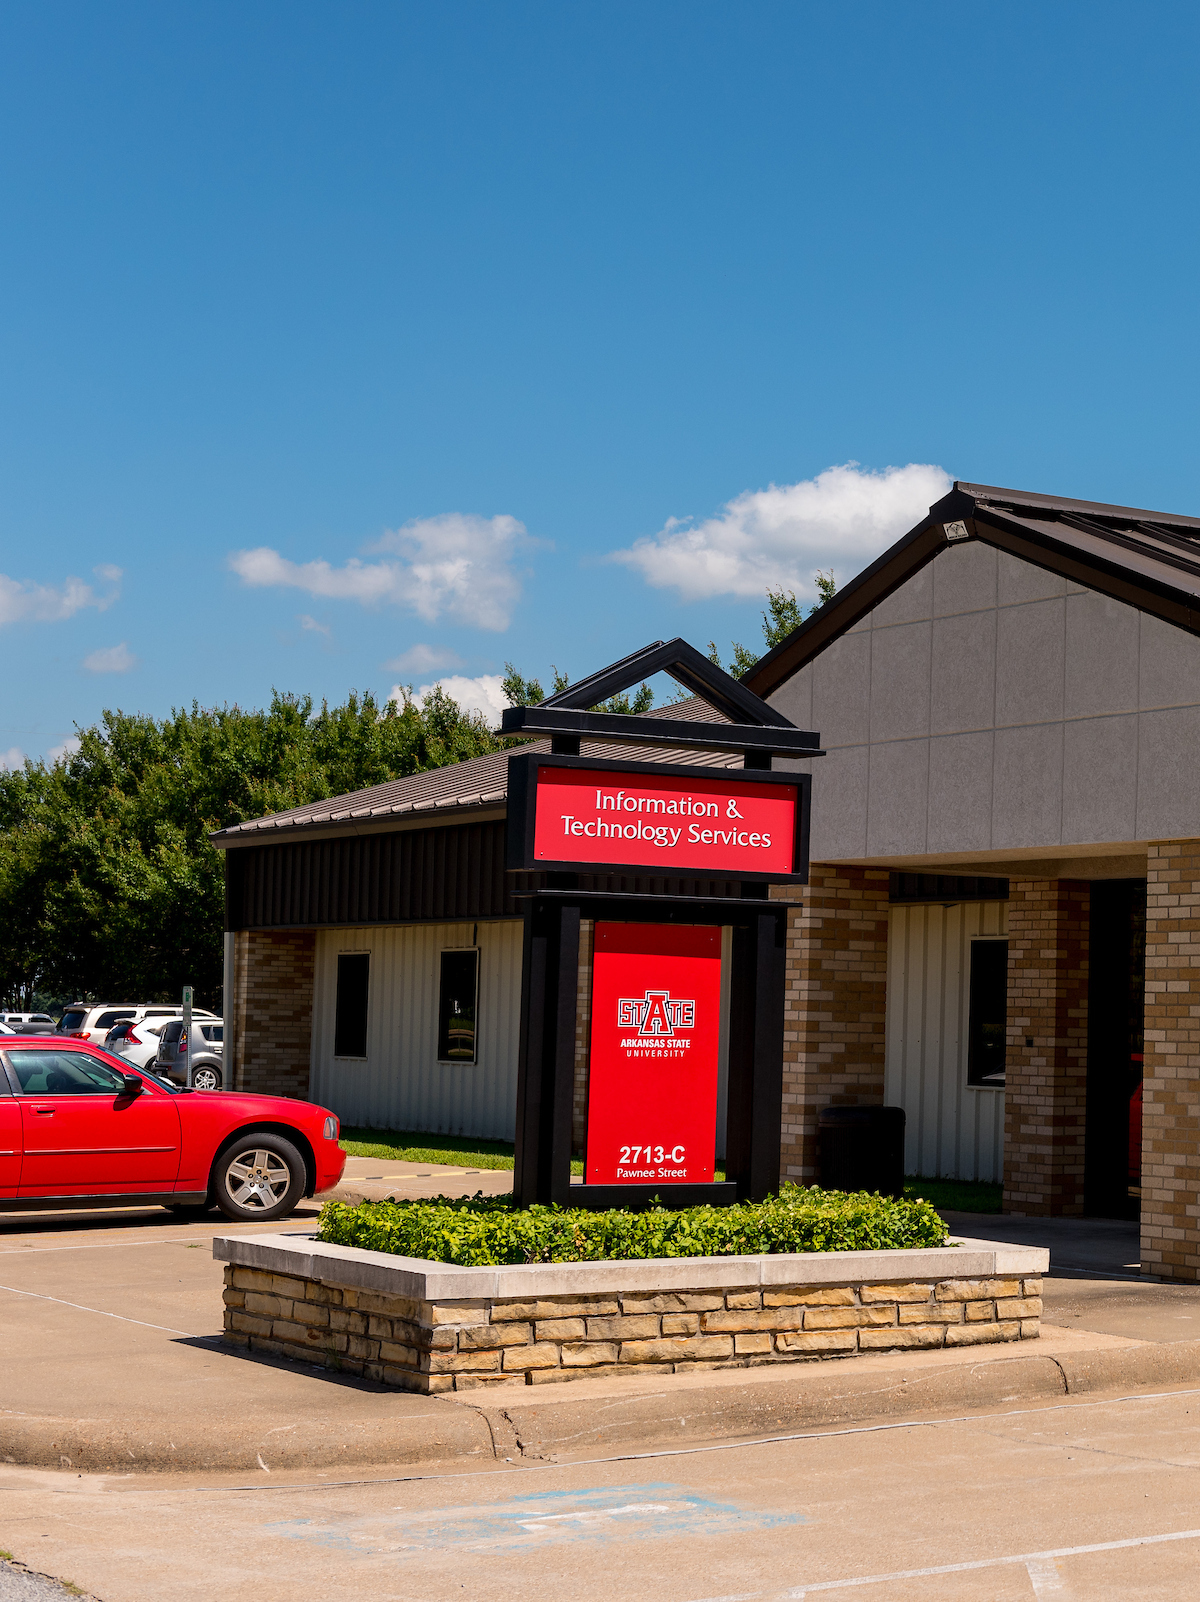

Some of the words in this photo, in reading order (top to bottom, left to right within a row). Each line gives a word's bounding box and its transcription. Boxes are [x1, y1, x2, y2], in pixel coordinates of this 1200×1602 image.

[596, 790, 719, 817] Information
[726, 799, 744, 819] &
[561, 815, 682, 847] Technology
[688, 824, 771, 848] Services
[618, 990, 695, 1036] STATE
[620, 1039, 666, 1048] ARKANSAS
[667, 1039, 691, 1049] STATE
[619, 1145, 686, 1164] 2713-C
[616, 1168, 655, 1178] Pawnee
[657, 1167, 687, 1178] Street
